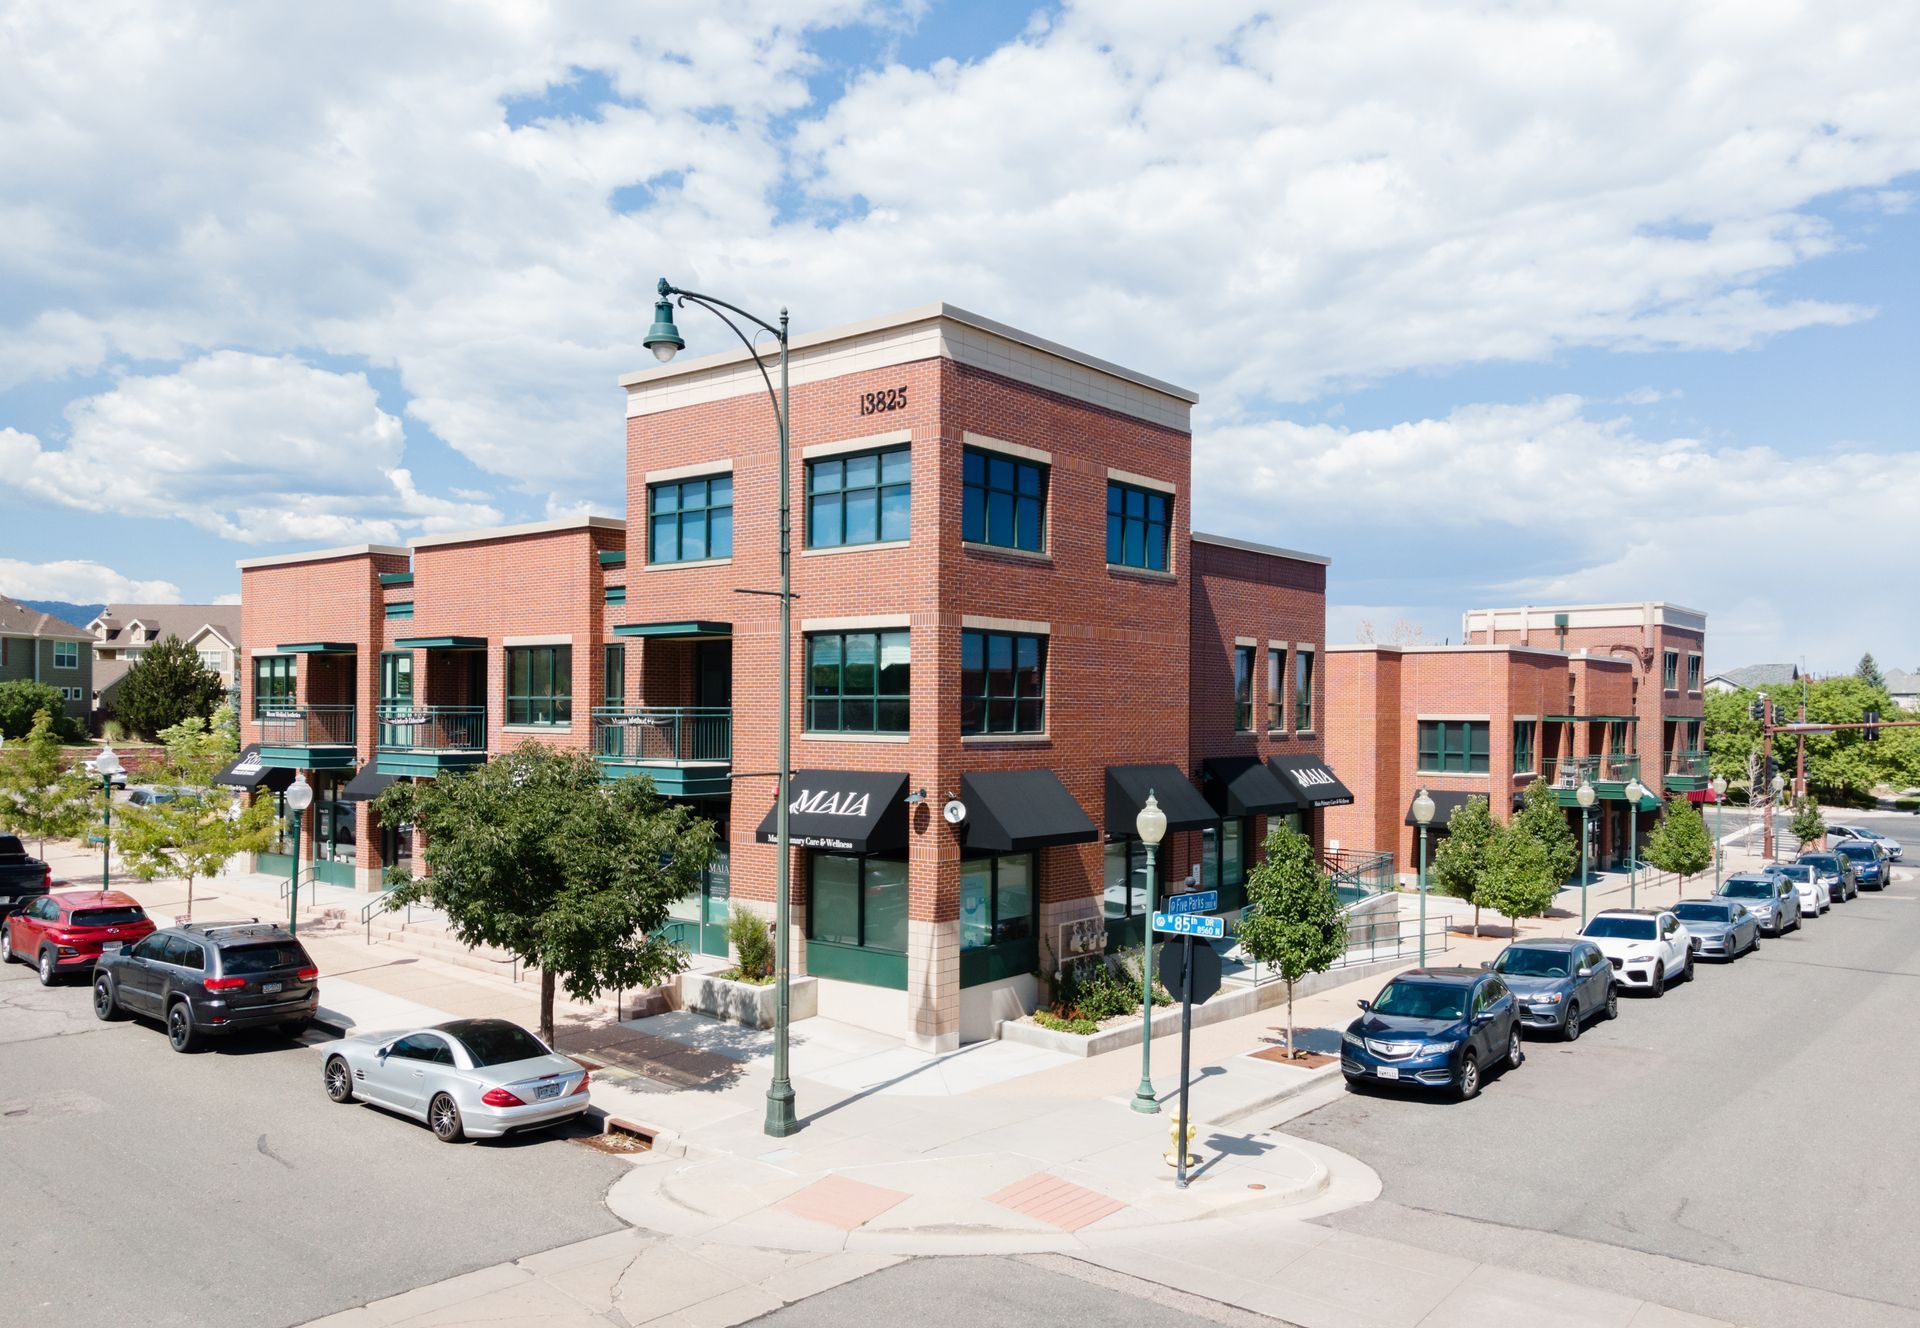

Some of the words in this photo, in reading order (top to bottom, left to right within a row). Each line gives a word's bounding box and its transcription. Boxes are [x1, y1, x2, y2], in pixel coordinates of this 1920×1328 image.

[861, 385, 907, 415] 13825
[1291, 768, 1335, 787] MAIA
[798, 789, 870, 817] MAIA
[805, 837, 819, 846] Care
[820, 838, 826, 847] &
[826, 839, 853, 848] Wellness
[708, 862, 729, 874] MAIA
[1176, 898, 1187, 912] Five
[1188, 897, 1203, 911] Parks
[1205, 918, 1214, 926] DR
[1197, 926, 1213, 935] 8560
